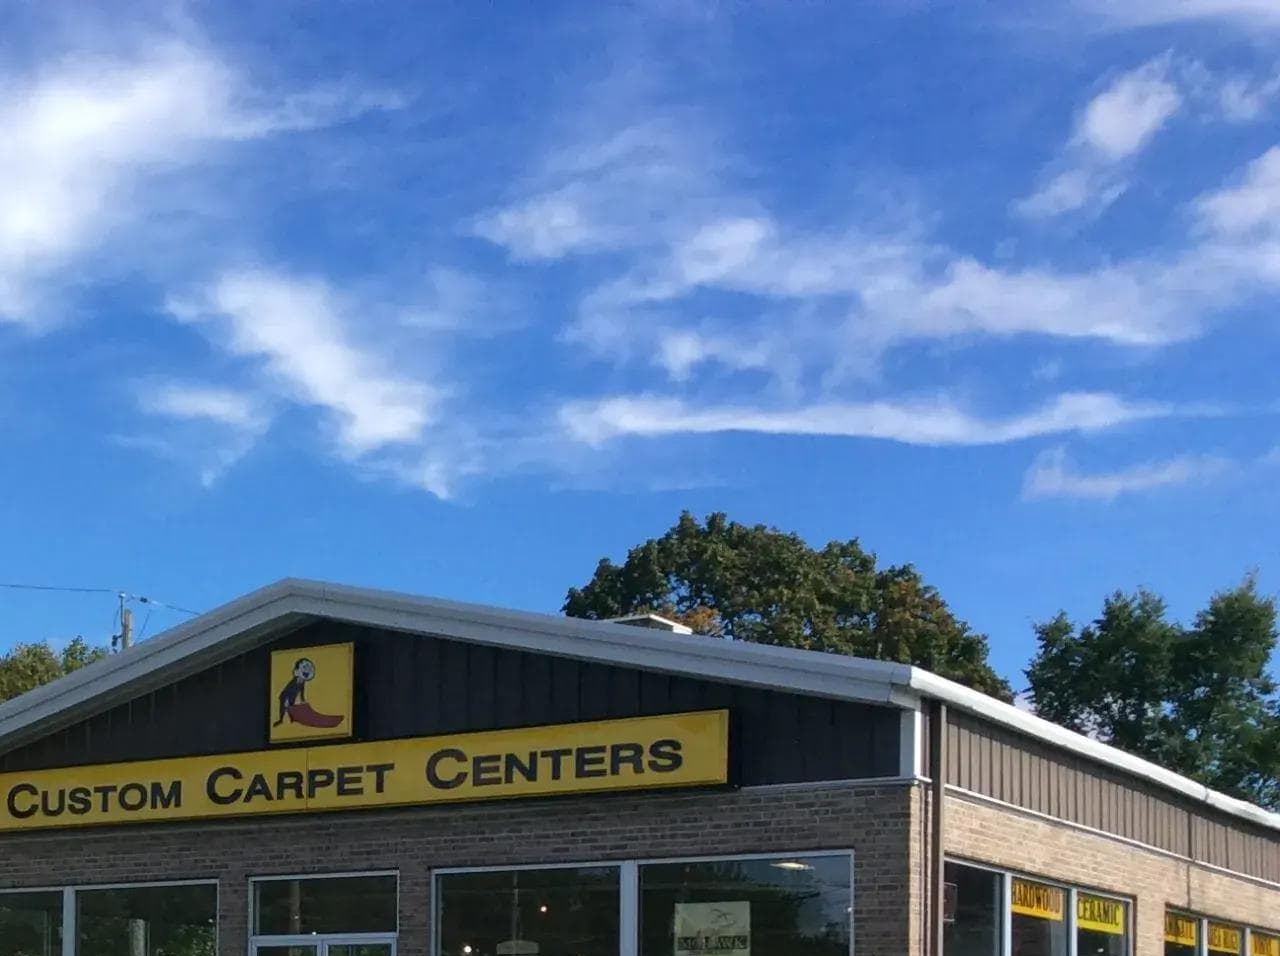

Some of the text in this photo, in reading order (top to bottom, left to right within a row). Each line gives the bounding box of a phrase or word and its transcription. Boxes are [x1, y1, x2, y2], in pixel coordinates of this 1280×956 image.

[7, 739, 683, 819] CUSTOM CARPET CENTERS
[1077, 896, 1120, 926] CERAMIC
